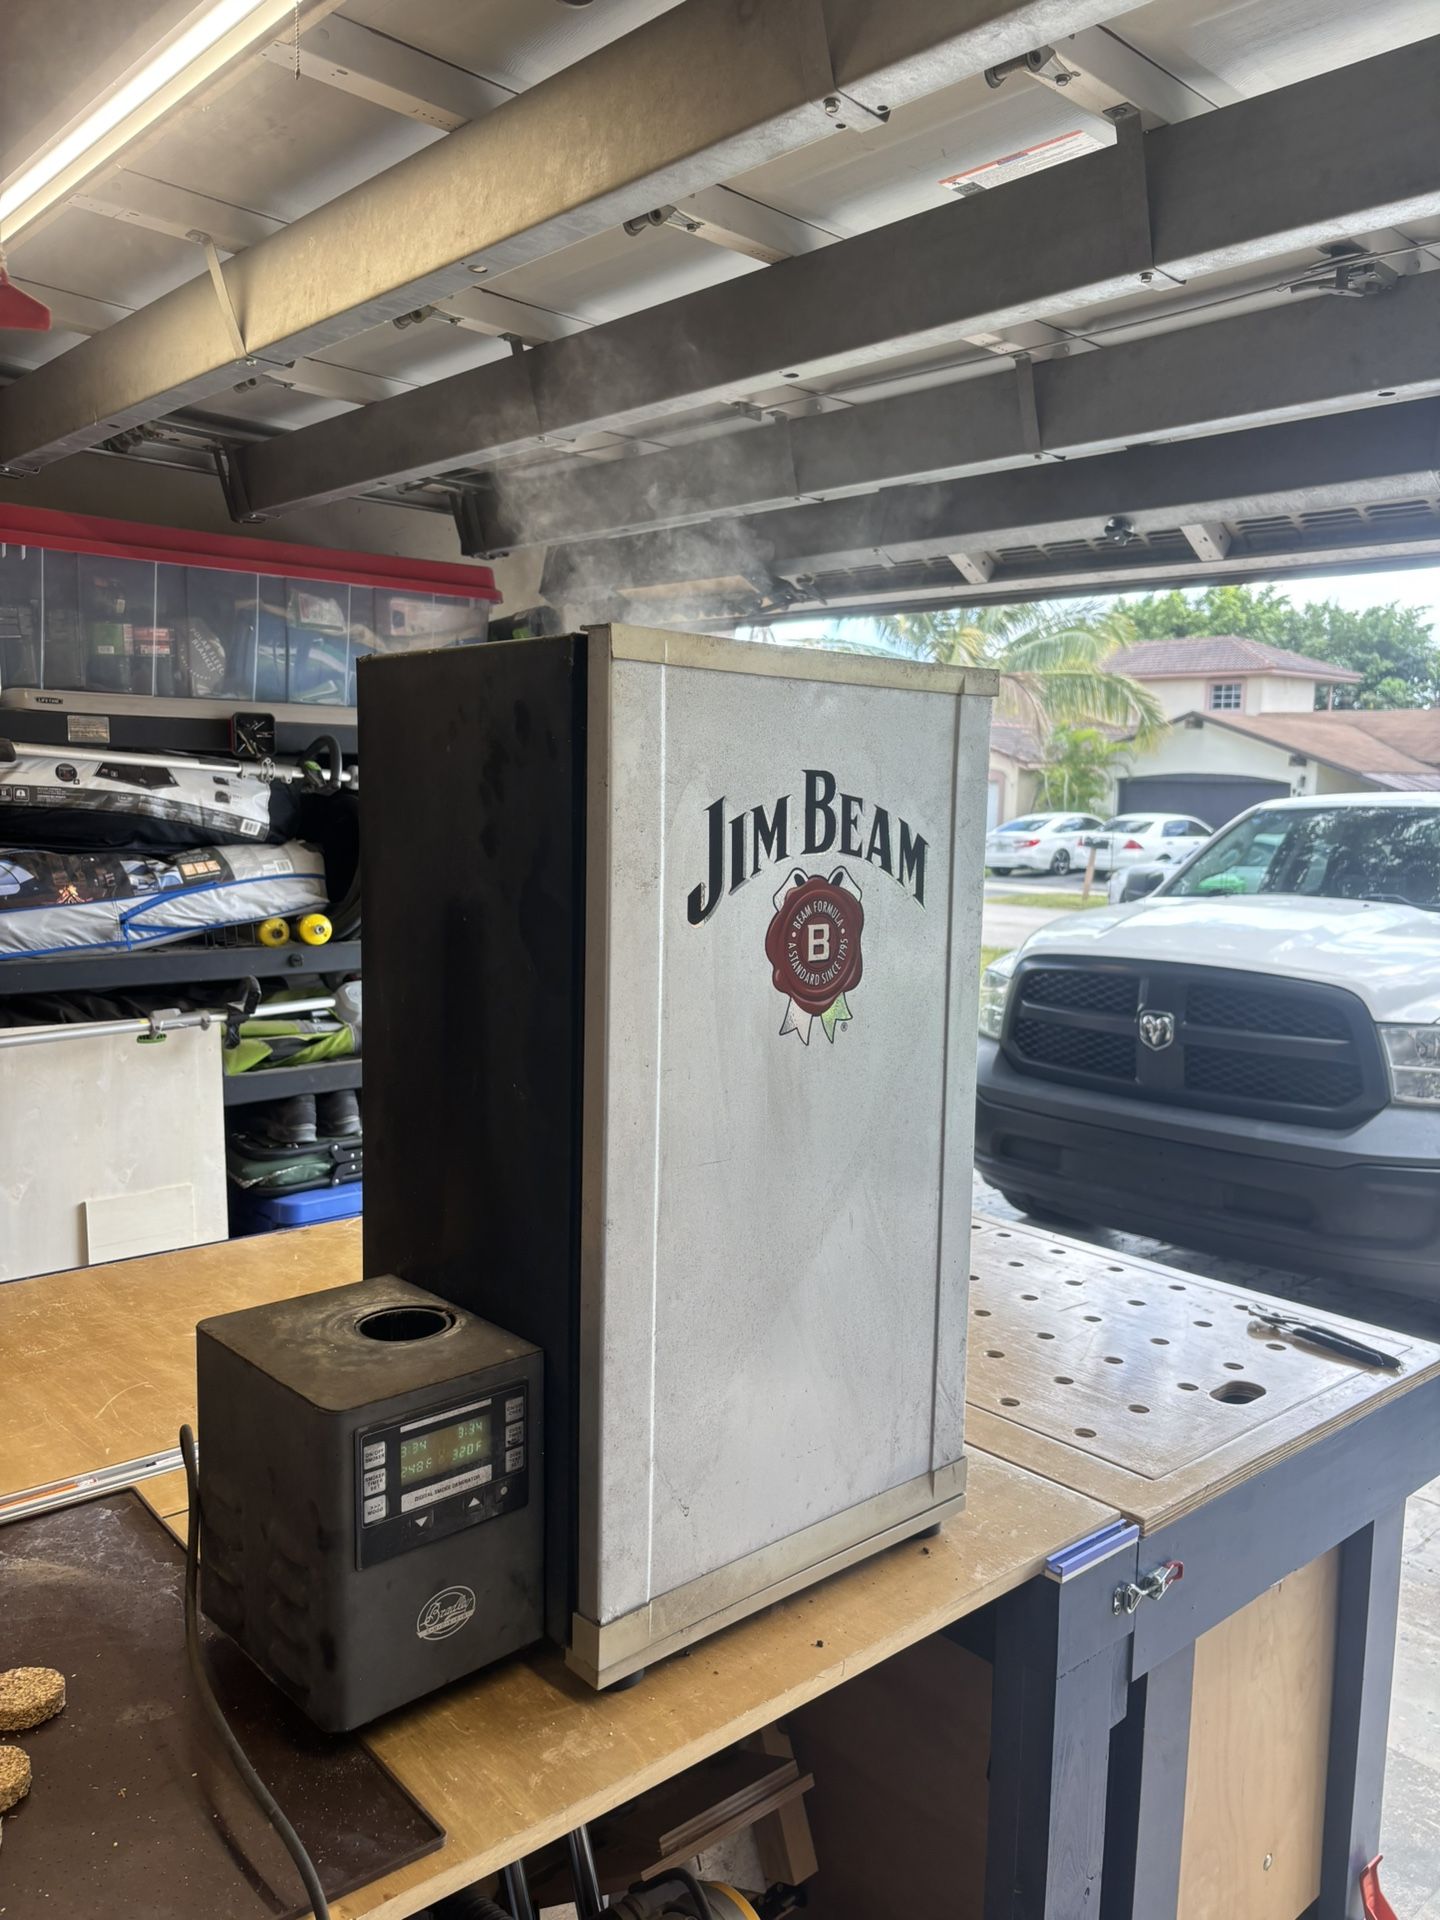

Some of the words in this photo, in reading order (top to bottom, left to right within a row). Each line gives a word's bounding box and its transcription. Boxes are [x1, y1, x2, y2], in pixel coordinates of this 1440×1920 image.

[192, 638, 217, 672] BLANKET
[687, 795, 792, 927] JIM
[799, 768, 929, 909] BEAM
[792, 904, 813, 930] BEAM
[813, 900, 844, 928] FORMULA
[788, 949, 820, 986] STANDARD
[821, 960, 842, 984] SINCE
[837, 938, 848, 961] 1795
[807, 923, 830, 962] B
